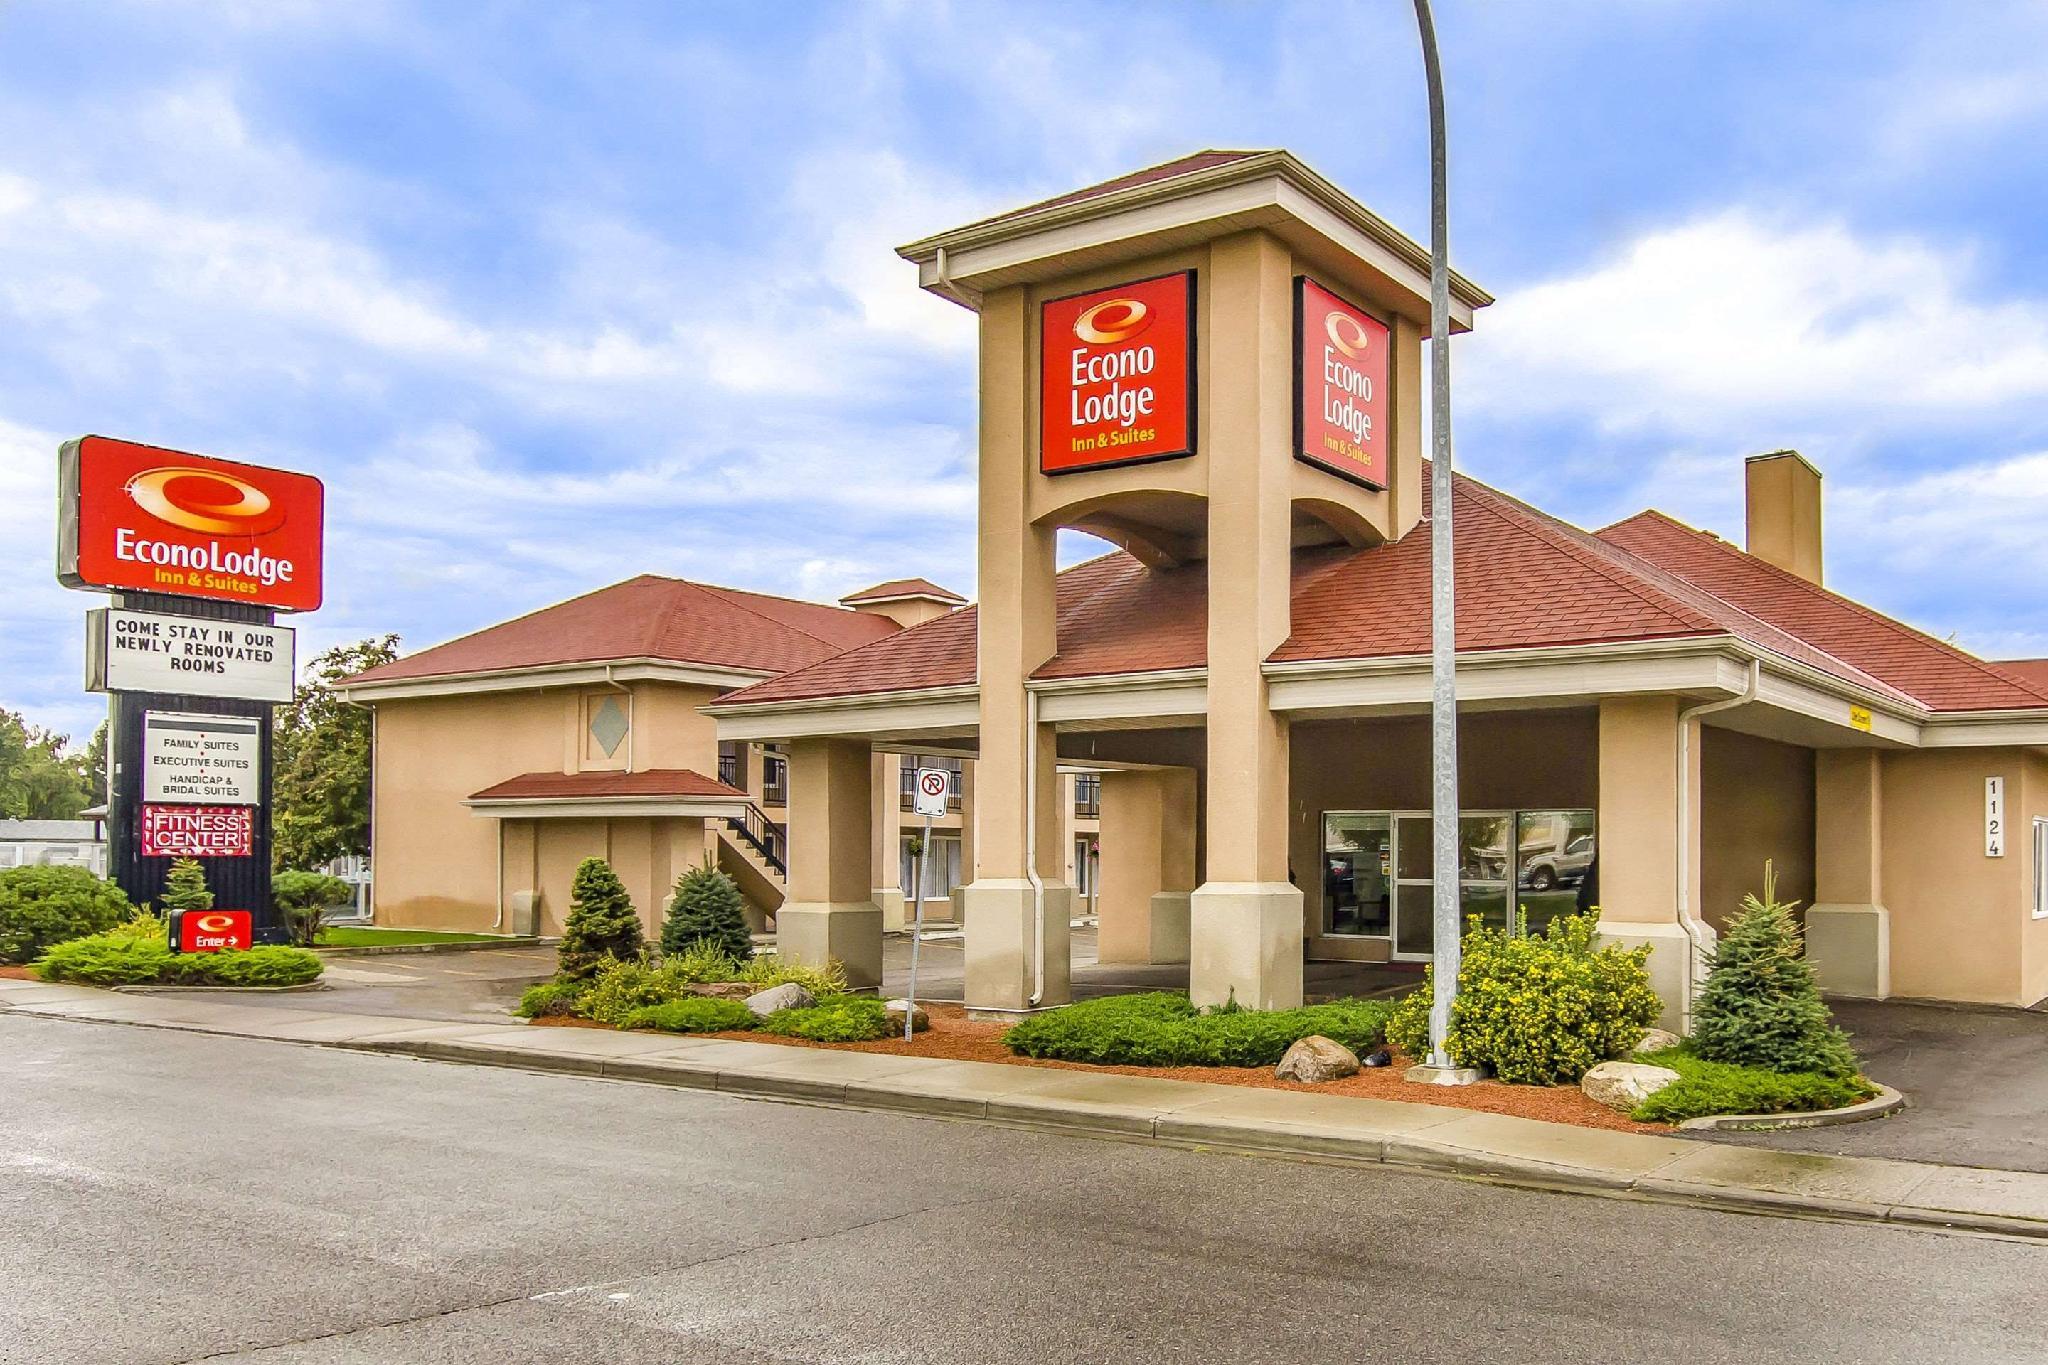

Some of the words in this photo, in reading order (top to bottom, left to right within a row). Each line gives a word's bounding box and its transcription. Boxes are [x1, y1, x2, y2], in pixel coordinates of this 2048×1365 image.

[1071, 346, 1154, 386] Econo
[1324, 345, 1372, 402] Econo
[1071, 382, 1154, 427] Lodge
[1324, 384, 1372, 444] Lodge
[1072, 437, 1095, 452] Inn
[1097, 433, 1108, 448] &
[1110, 427, 1155, 446] Suites
[1324, 431, 1339, 452] Inn
[1339, 441, 1346, 456] &
[1347, 443, 1372, 466] Suites
[116, 528, 293, 585] EconoLodge
[155, 568, 184, 584] Inn
[188, 573, 202, 587] &
[204, 575, 258, 594] Suites
[116, 619, 160, 637] COME
[169, 625, 209, 641] STAY
[218, 630, 233, 644] IN
[245, 633, 274, 647] OUR
[116, 636, 172, 653] NEWLY
[184, 643, 273, 662] RENOVATED
[170, 657, 225, 673] ROOMS
[163, 738, 199, 749] FAMILY
[204, 741, 239, 751] SUITES
[153, 756, 211, 767] EXECUTIVE
[213, 759, 249, 769] SUITES
[163, 785, 201, 795] BRIDAL
[204, 787, 239, 796] SUITES
[170, 775, 223, 785] HANDICAP
[226, 777, 232, 785] &
[156, 815, 239, 831] FITNESS
[156, 831, 239, 846] CENTER
[196, 936, 226, 947] Enter
